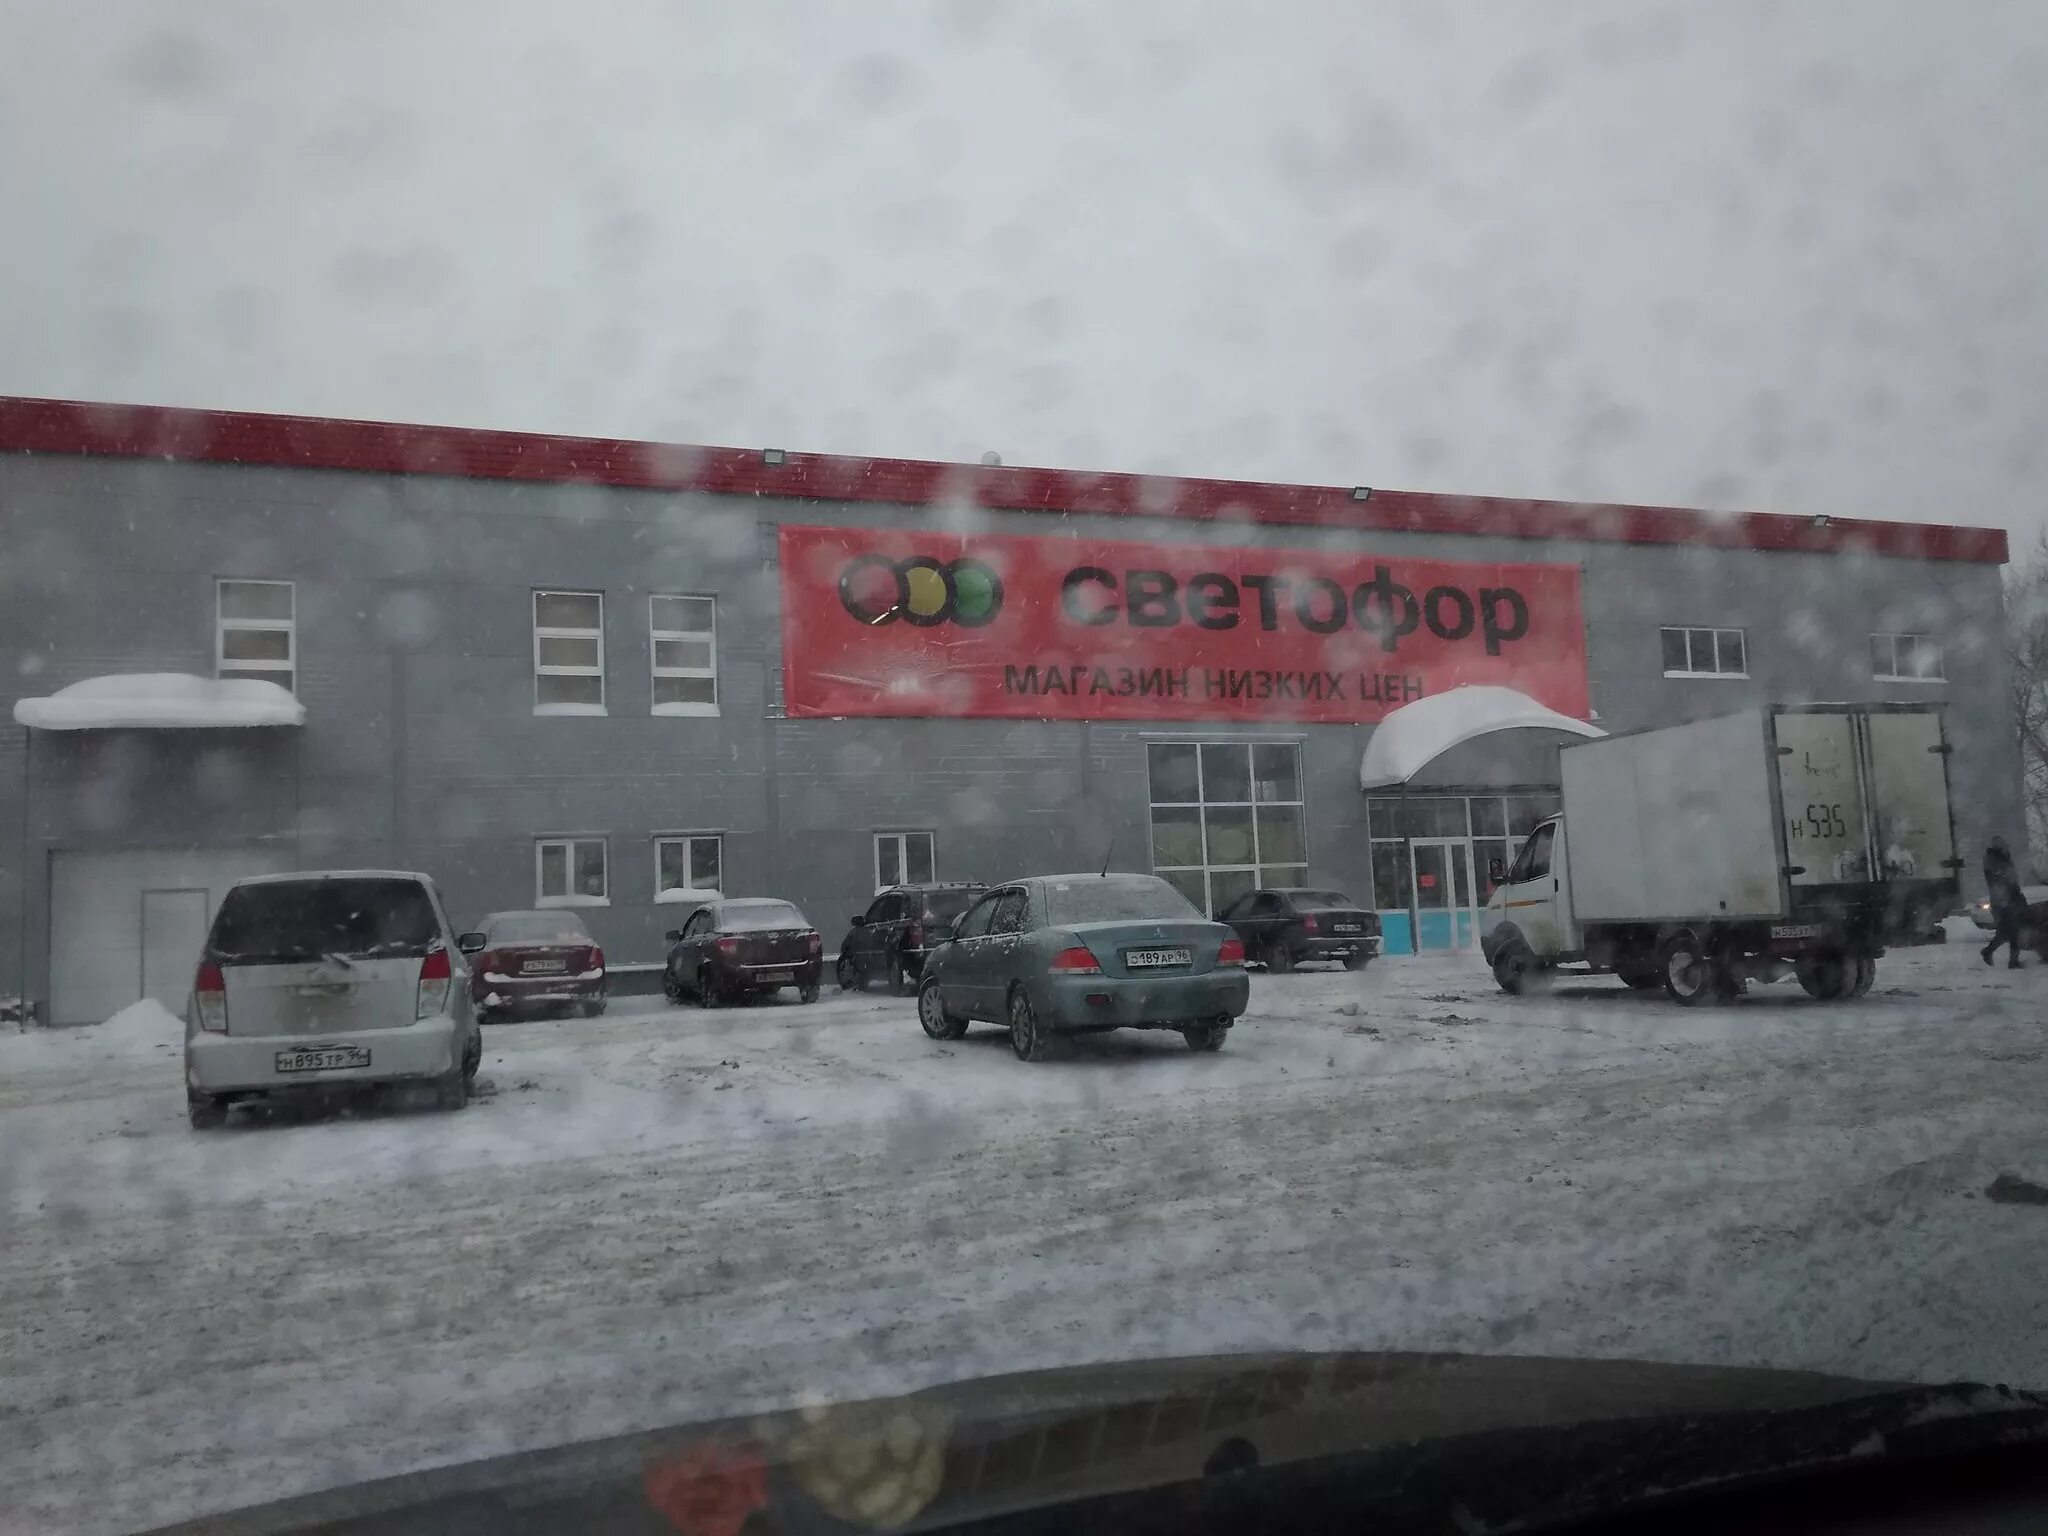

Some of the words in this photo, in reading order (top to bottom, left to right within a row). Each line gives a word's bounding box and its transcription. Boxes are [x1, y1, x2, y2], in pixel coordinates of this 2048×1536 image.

[1004, 664, 1190, 697] МАГАЗИН
[1204, 667, 1344, 700] НИЗКИХ
[1359, 672, 1423, 703] ЦЕН
